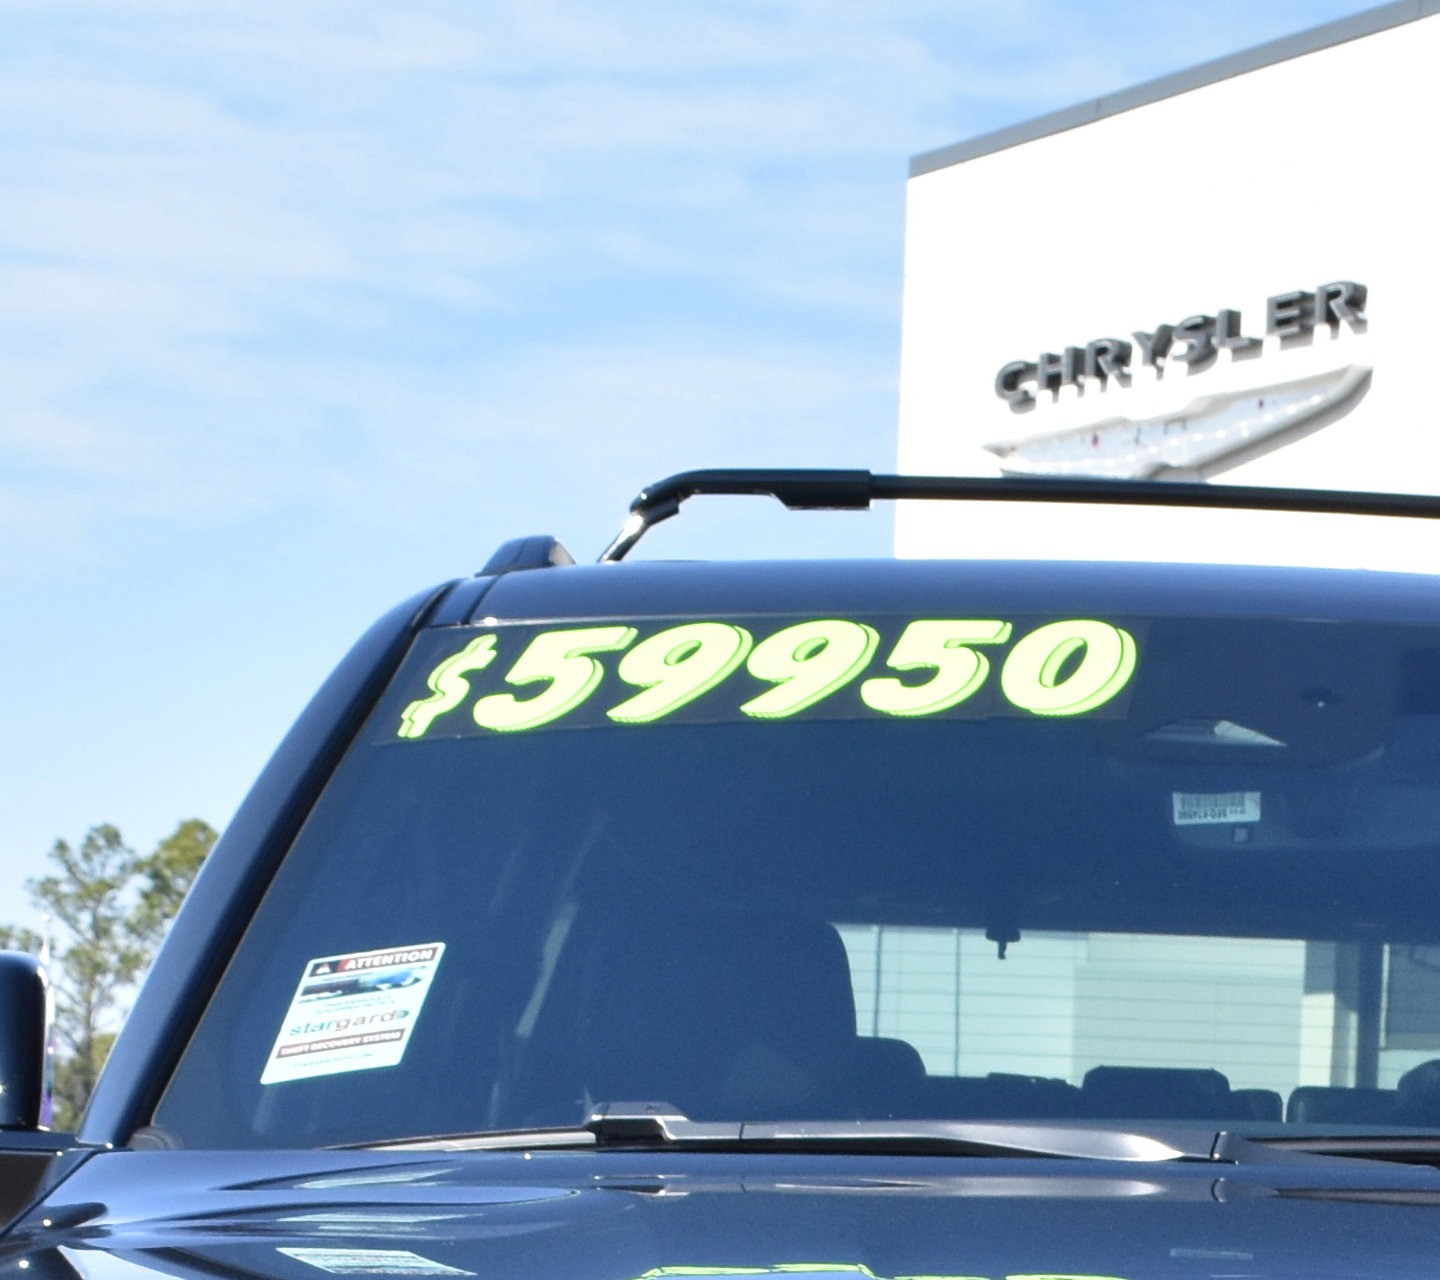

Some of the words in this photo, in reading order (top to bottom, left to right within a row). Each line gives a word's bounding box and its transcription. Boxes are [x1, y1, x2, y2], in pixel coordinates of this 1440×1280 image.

[996, 280, 1368, 412] CHRYSLER
[397, 618, 1138, 739] $59950
[345, 949, 433, 970] ATTENTION
[288, 1009, 398, 1036] stargard
